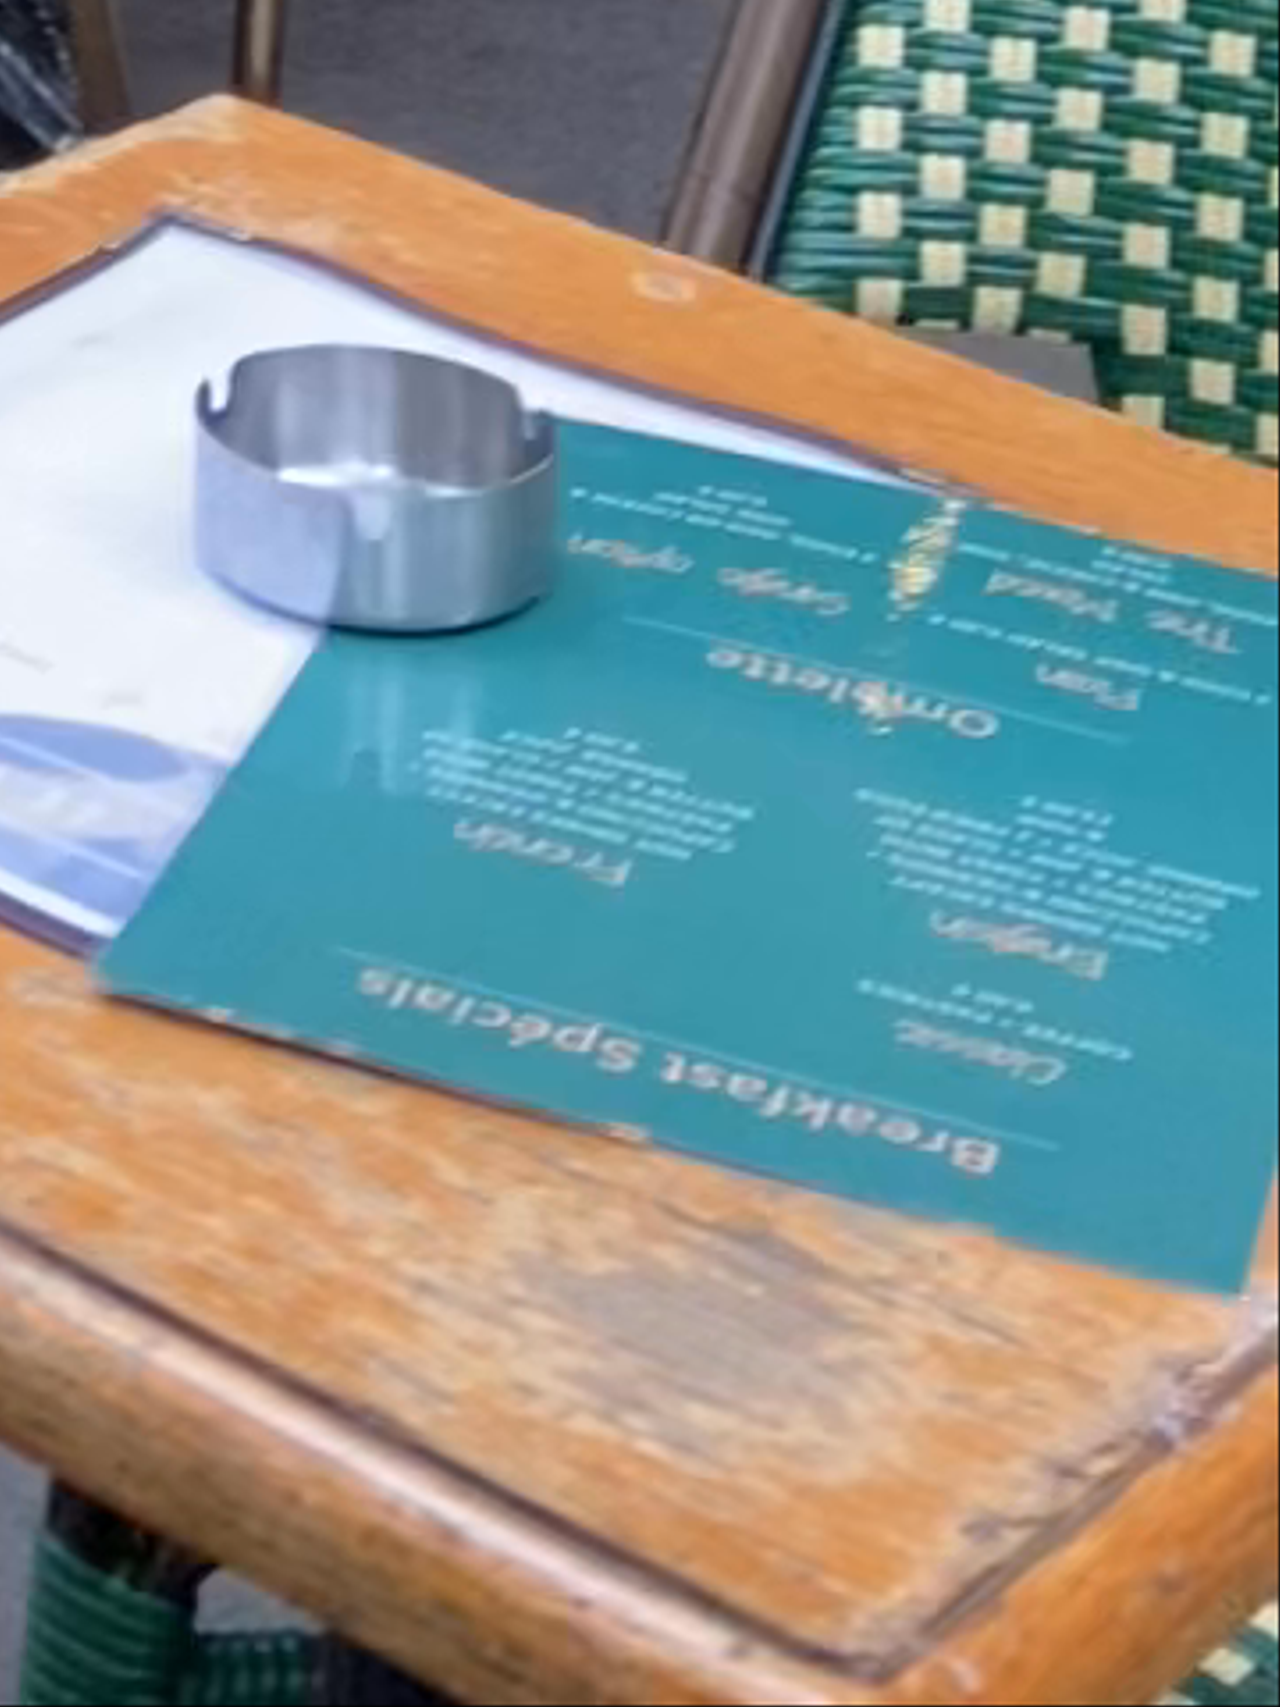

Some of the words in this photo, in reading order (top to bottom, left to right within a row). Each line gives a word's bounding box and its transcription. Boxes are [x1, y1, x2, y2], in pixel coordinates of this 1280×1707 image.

[703, 644, 1001, 741] Omelette
[352, 967, 643, 1076] Spécials
[658, 1049, 1002, 1177] Breakfast
